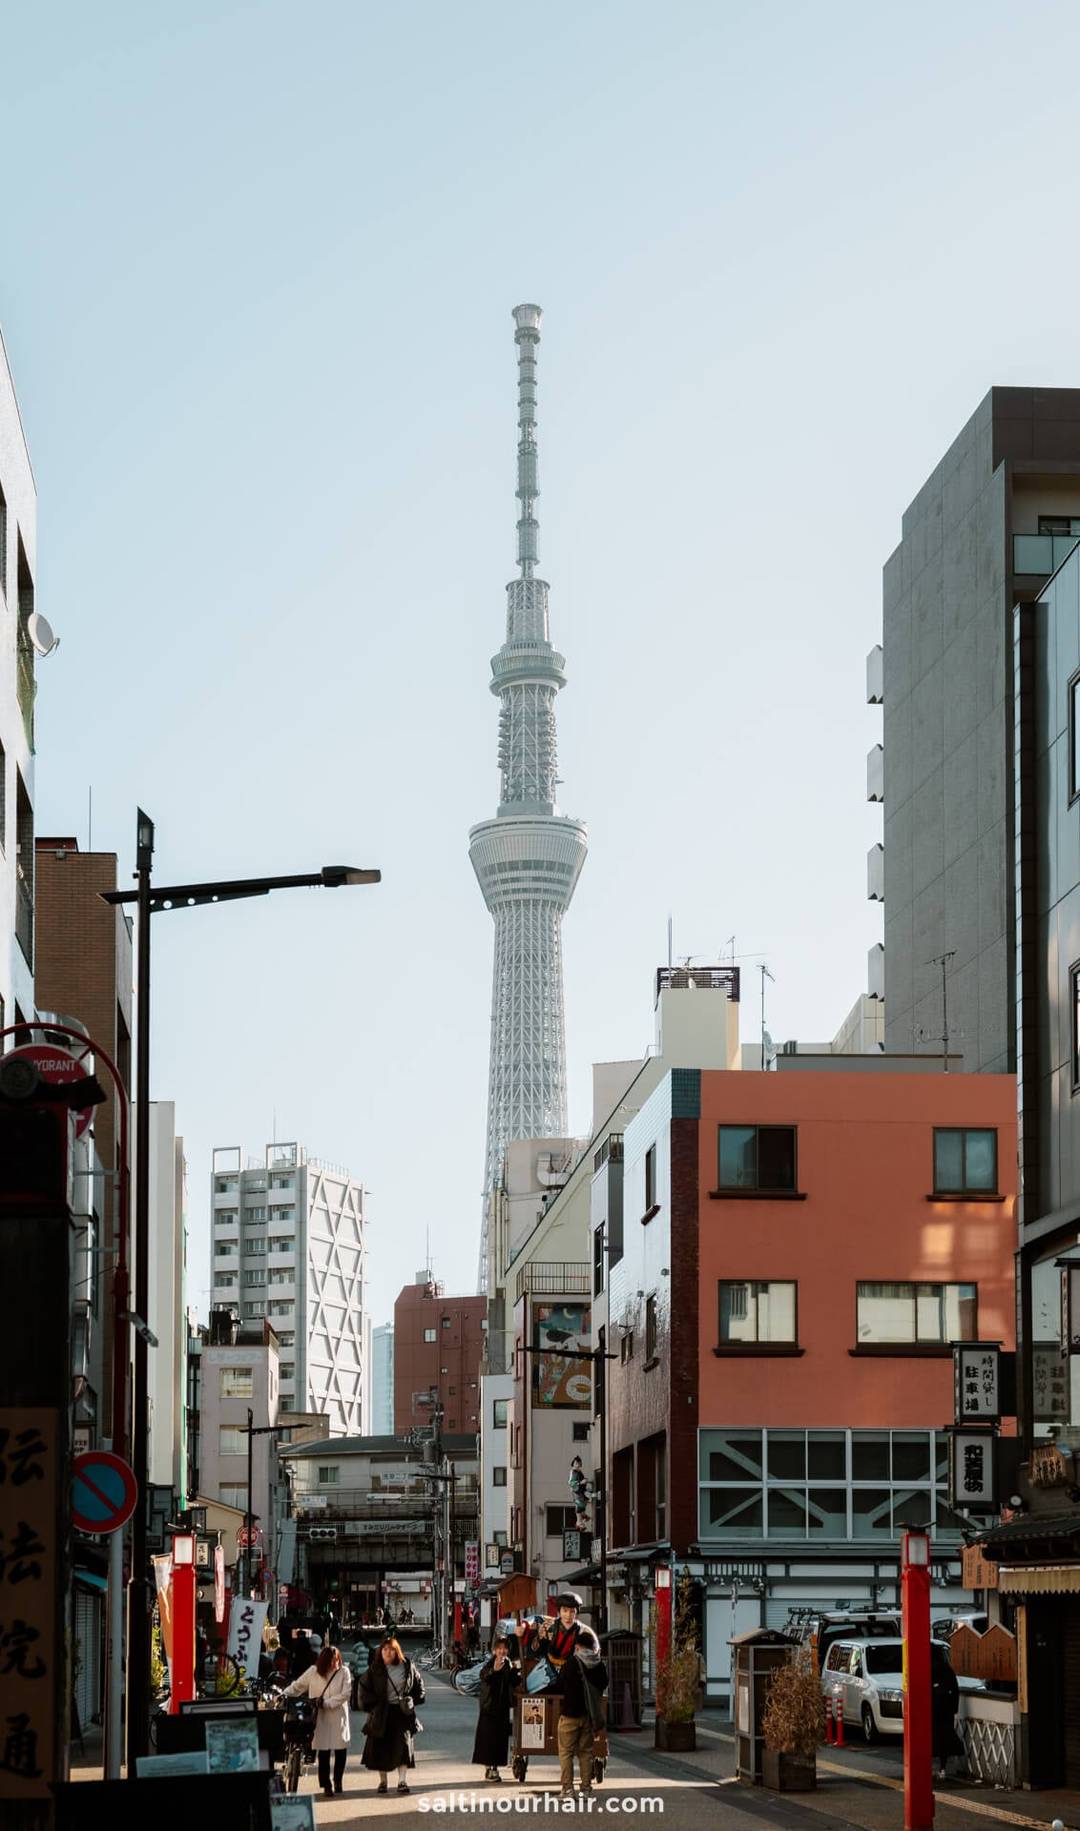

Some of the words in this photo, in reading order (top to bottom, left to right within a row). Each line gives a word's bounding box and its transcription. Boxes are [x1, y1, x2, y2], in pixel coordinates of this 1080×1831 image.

[965, 1366, 979, 1411] 駐車場
[982, 1355, 995, 1407] 時間貸し
[233, 1606, 254, 1662] とうふ
